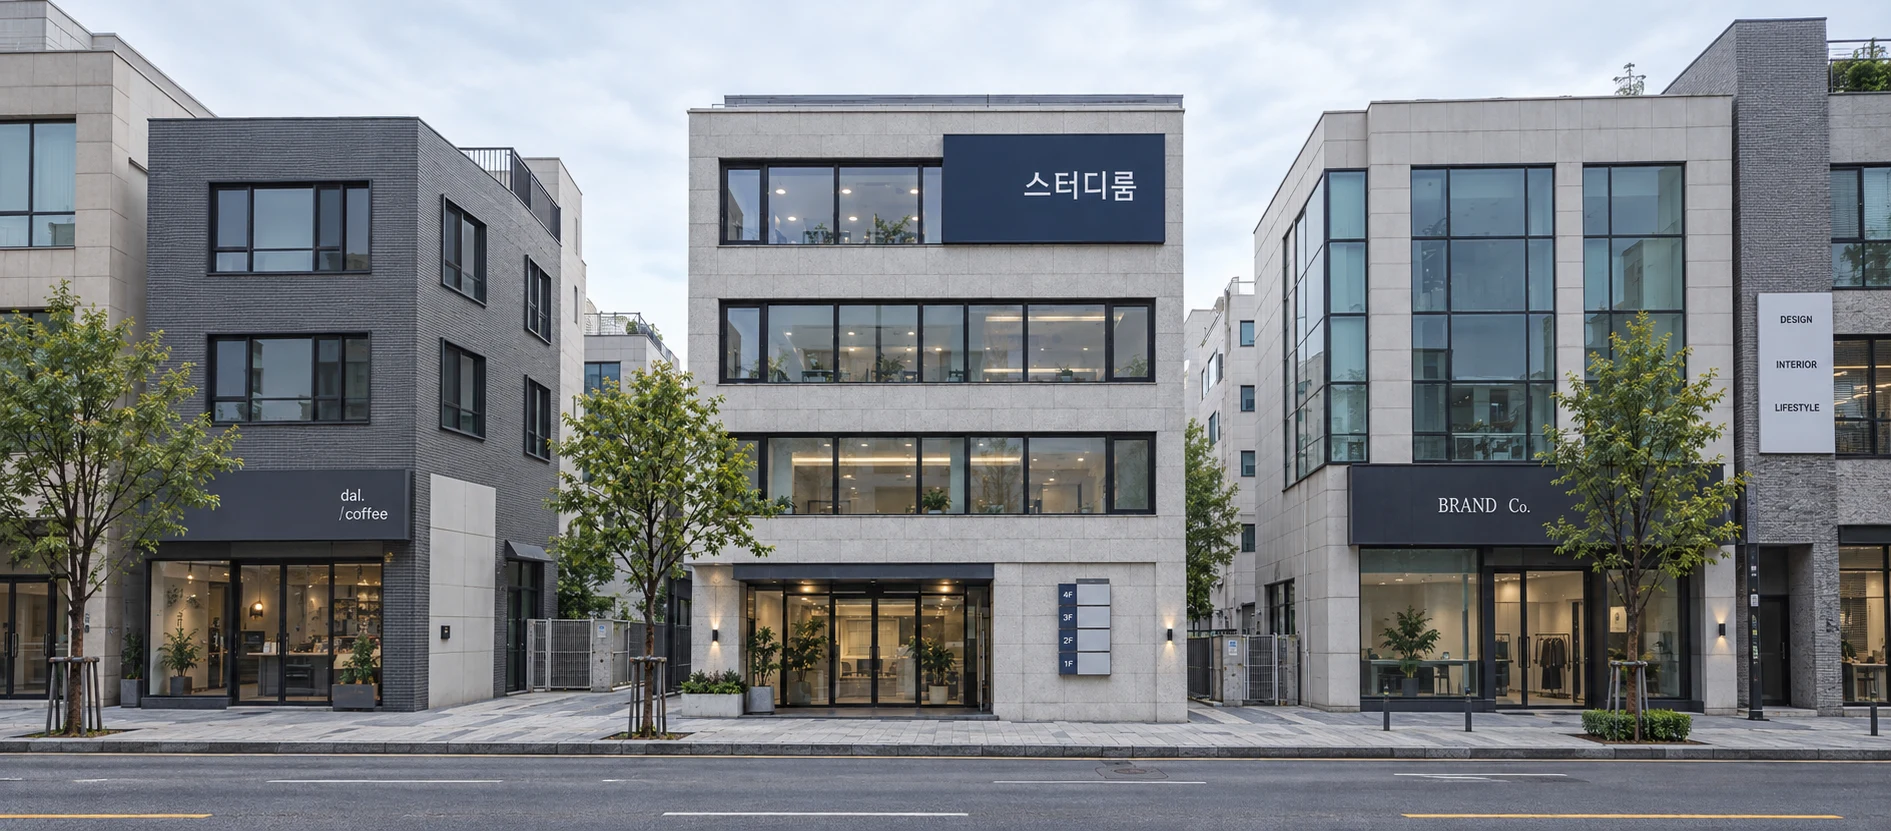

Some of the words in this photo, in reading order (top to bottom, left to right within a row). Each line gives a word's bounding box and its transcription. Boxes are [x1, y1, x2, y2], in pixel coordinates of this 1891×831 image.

[1023, 170, 1137, 202] 스터디룸
[1780, 315, 1813, 324] DESIGN
[1776, 360, 1818, 369] INTERIOR
[1775, 403, 1820, 412] LIFESTYLE
[340, 488, 365, 502] dal.
[1438, 497, 1497, 513] BRAND
[1508, 497, 1531, 513] Co.
[1063, 590, 1073, 599] 4F
[1063, 613, 1073, 622] 3F
[1063, 636, 1074, 645] 2F
[1064, 660, 1074, 668] 1F
